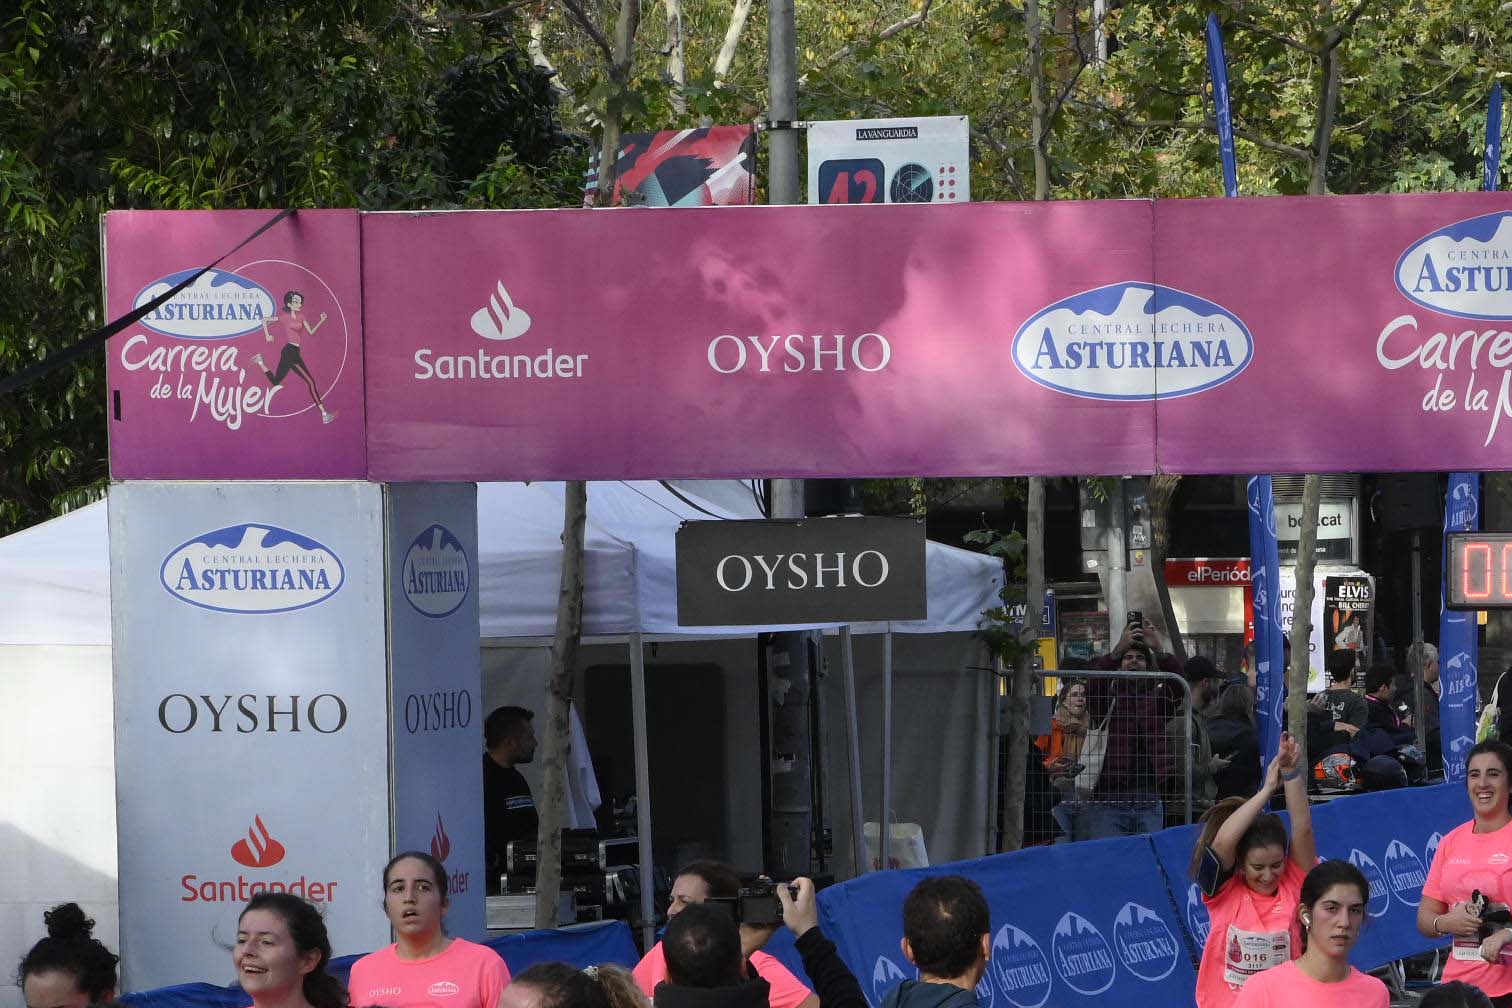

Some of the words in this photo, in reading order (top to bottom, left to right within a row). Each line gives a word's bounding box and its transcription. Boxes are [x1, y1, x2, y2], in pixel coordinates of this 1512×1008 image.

[1067, 323, 1144, 336] CENTRAL
[1151, 321, 1226, 334] LECHERA
[121, 335, 239, 372] Carrera
[414, 348, 589, 380] Santander
[706, 332, 892, 374] OYSHO
[1030, 326, 1235, 370] ASTURIANA
[151, 375, 172, 399] de
[177, 374, 193, 399] la
[190, 369, 283, 430] Mujer
[1422, 373, 1457, 412] de
[1464, 372, 1489, 412] la
[175, 557, 332, 591] ASTURIANA
[203, 555, 260, 565] CENTRAL
[266, 555, 325, 564] LECHERA
[716, 550, 890, 592] OYSHO
[1187, 566, 1252, 583] elPeriód
[408, 567, 466, 594] ASTURIANA
[1338, 585, 1369, 598] ELVIS
[1339, 601, 1350, 609] BILL
[158, 693, 348, 734] OYSHO
[405, 689, 472, 735] OYSHO
[1058, 946, 1112, 978] ASTURIANA
[1244, 953, 1267, 962] 016
[998, 959, 1048, 992] ASTURIANA
